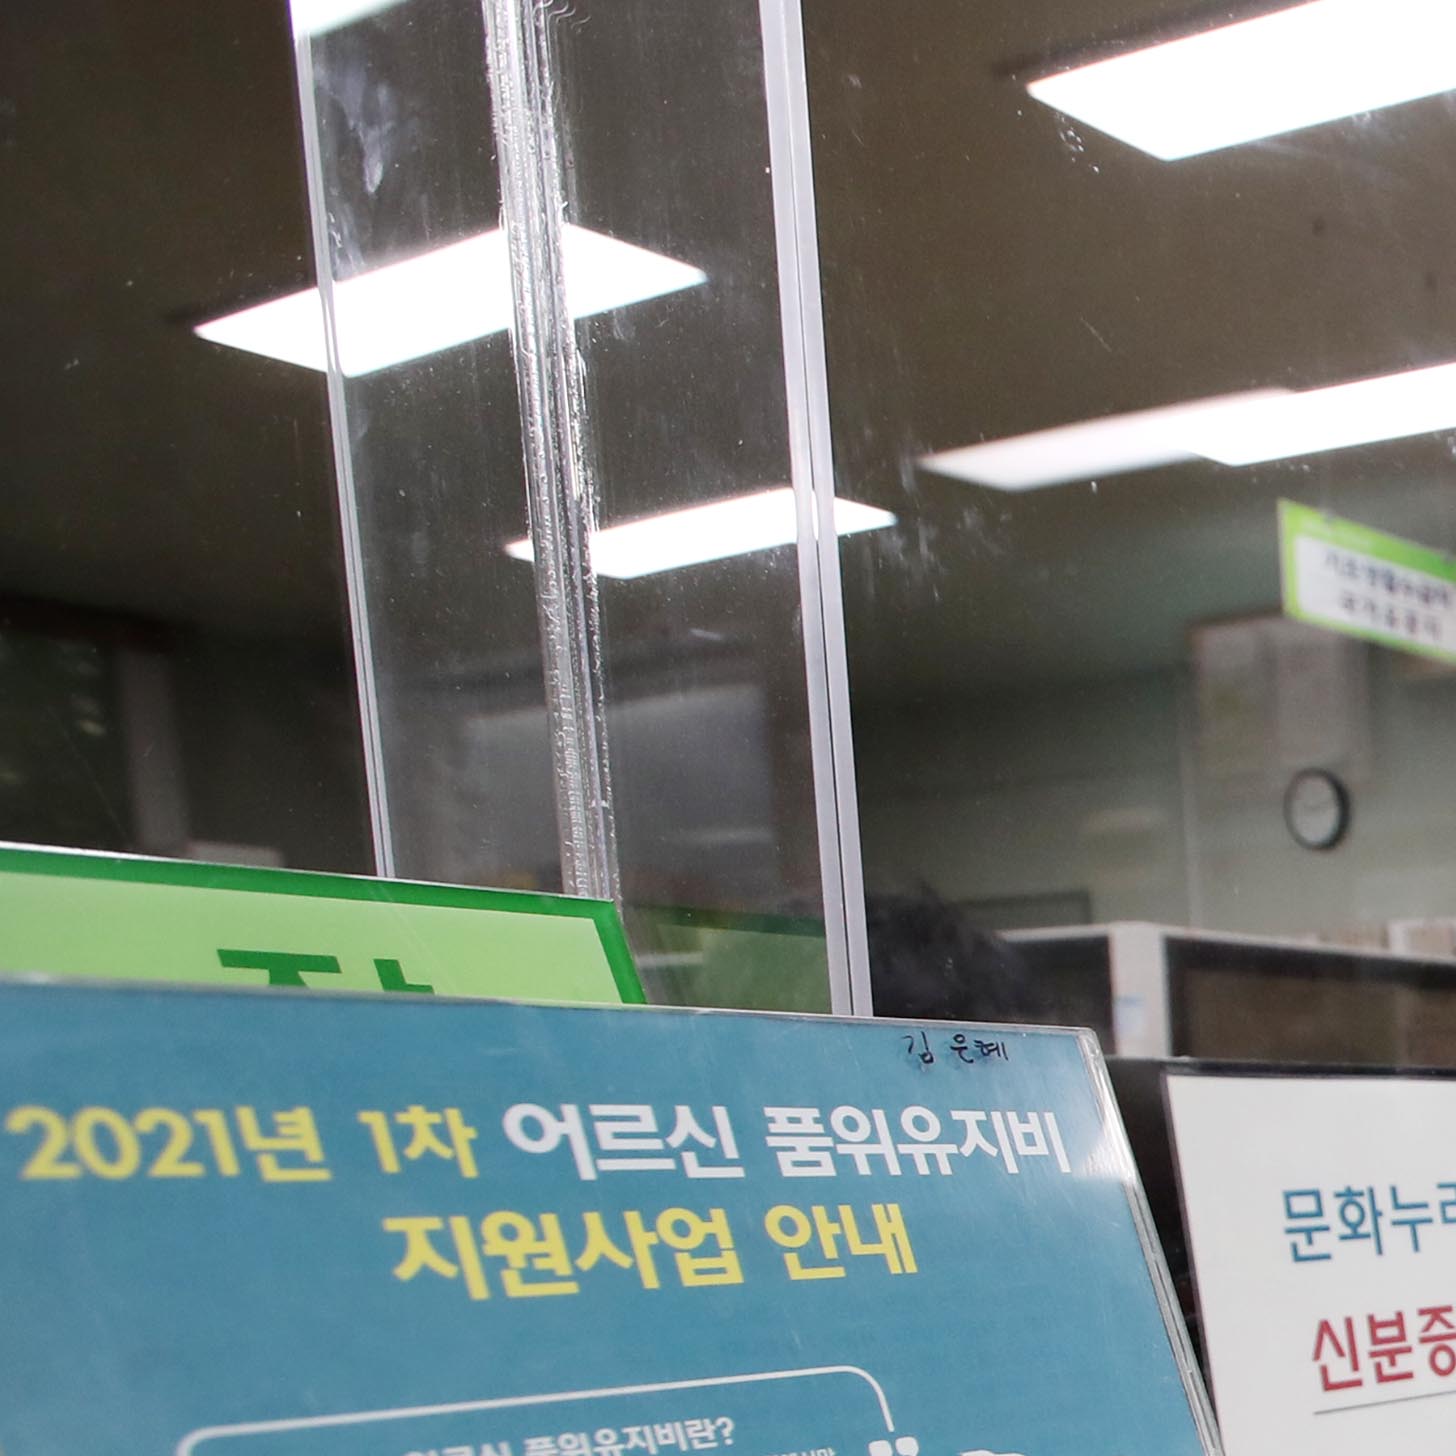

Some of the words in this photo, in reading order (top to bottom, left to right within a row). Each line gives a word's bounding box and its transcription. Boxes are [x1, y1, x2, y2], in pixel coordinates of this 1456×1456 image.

[5, 1105, 332, 1183] 2021년
[359, 1105, 479, 1180] 1차
[503, 1102, 746, 1181] 어르신
[766, 1105, 1070, 1179] 품위유지비
[382, 1207, 745, 1301] 지원사업
[766, 1202, 918, 1281] 안내
